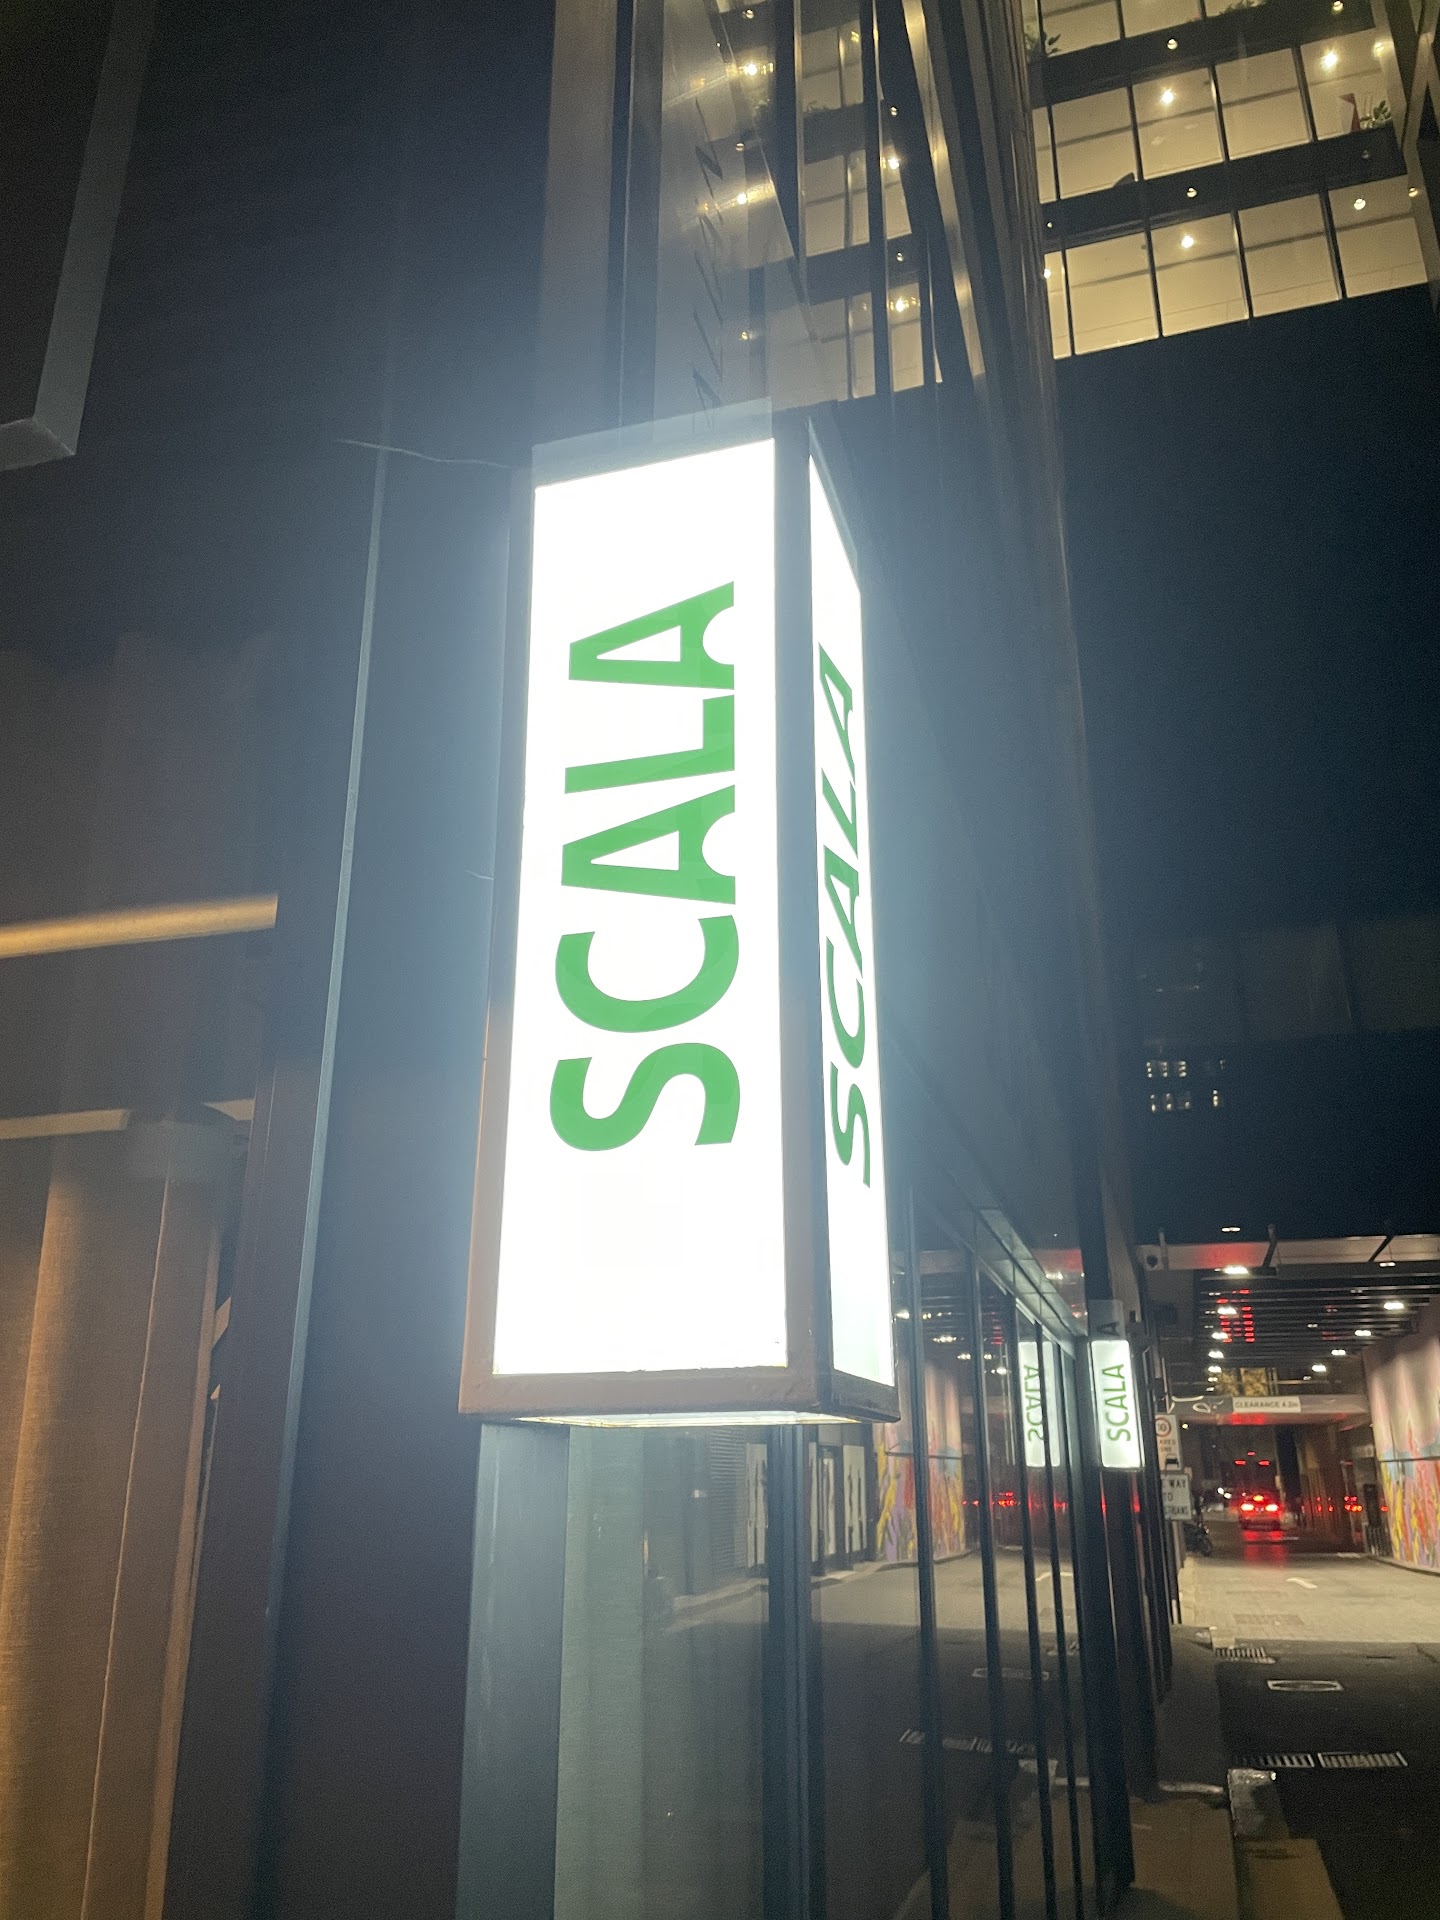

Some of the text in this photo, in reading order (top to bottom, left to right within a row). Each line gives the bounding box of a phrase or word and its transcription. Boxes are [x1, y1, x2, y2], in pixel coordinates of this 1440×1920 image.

[550, 581, 740, 1151] SCALA
[819, 642, 870, 1188] SCALA
[1102, 1364, 1131, 1441] SCALA
[1235, 1400, 1280, 1408] CLEARANCE
[1169, 1479, 1186, 1488] WAY
